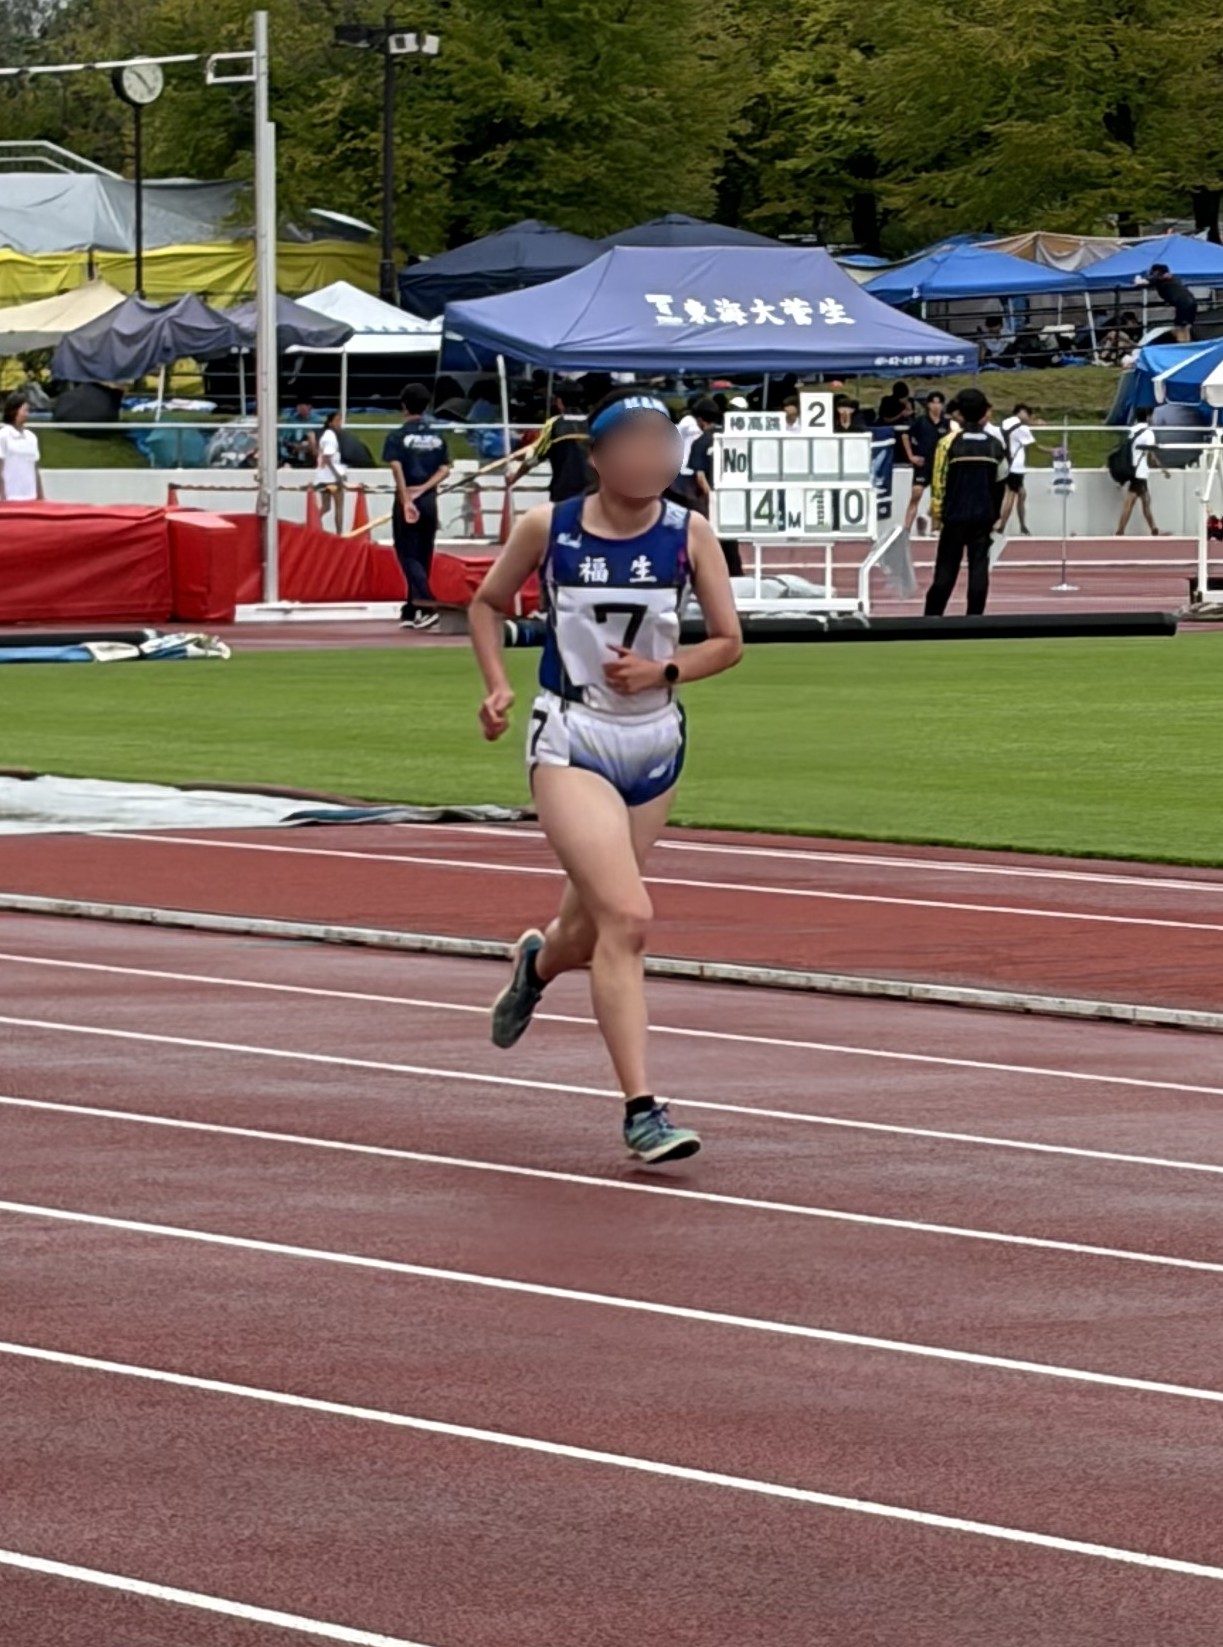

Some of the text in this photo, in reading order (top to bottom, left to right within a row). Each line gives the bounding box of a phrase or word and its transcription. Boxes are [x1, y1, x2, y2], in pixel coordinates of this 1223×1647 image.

[808, 401, 826, 427] 2
[723, 447, 748, 473] No
[753, 488, 775, 526] 4
[788, 511, 802, 529] M
[578, 554, 658, 584] 福生
[593, 603, 649, 650] 7
[531, 708, 549, 757] 7
